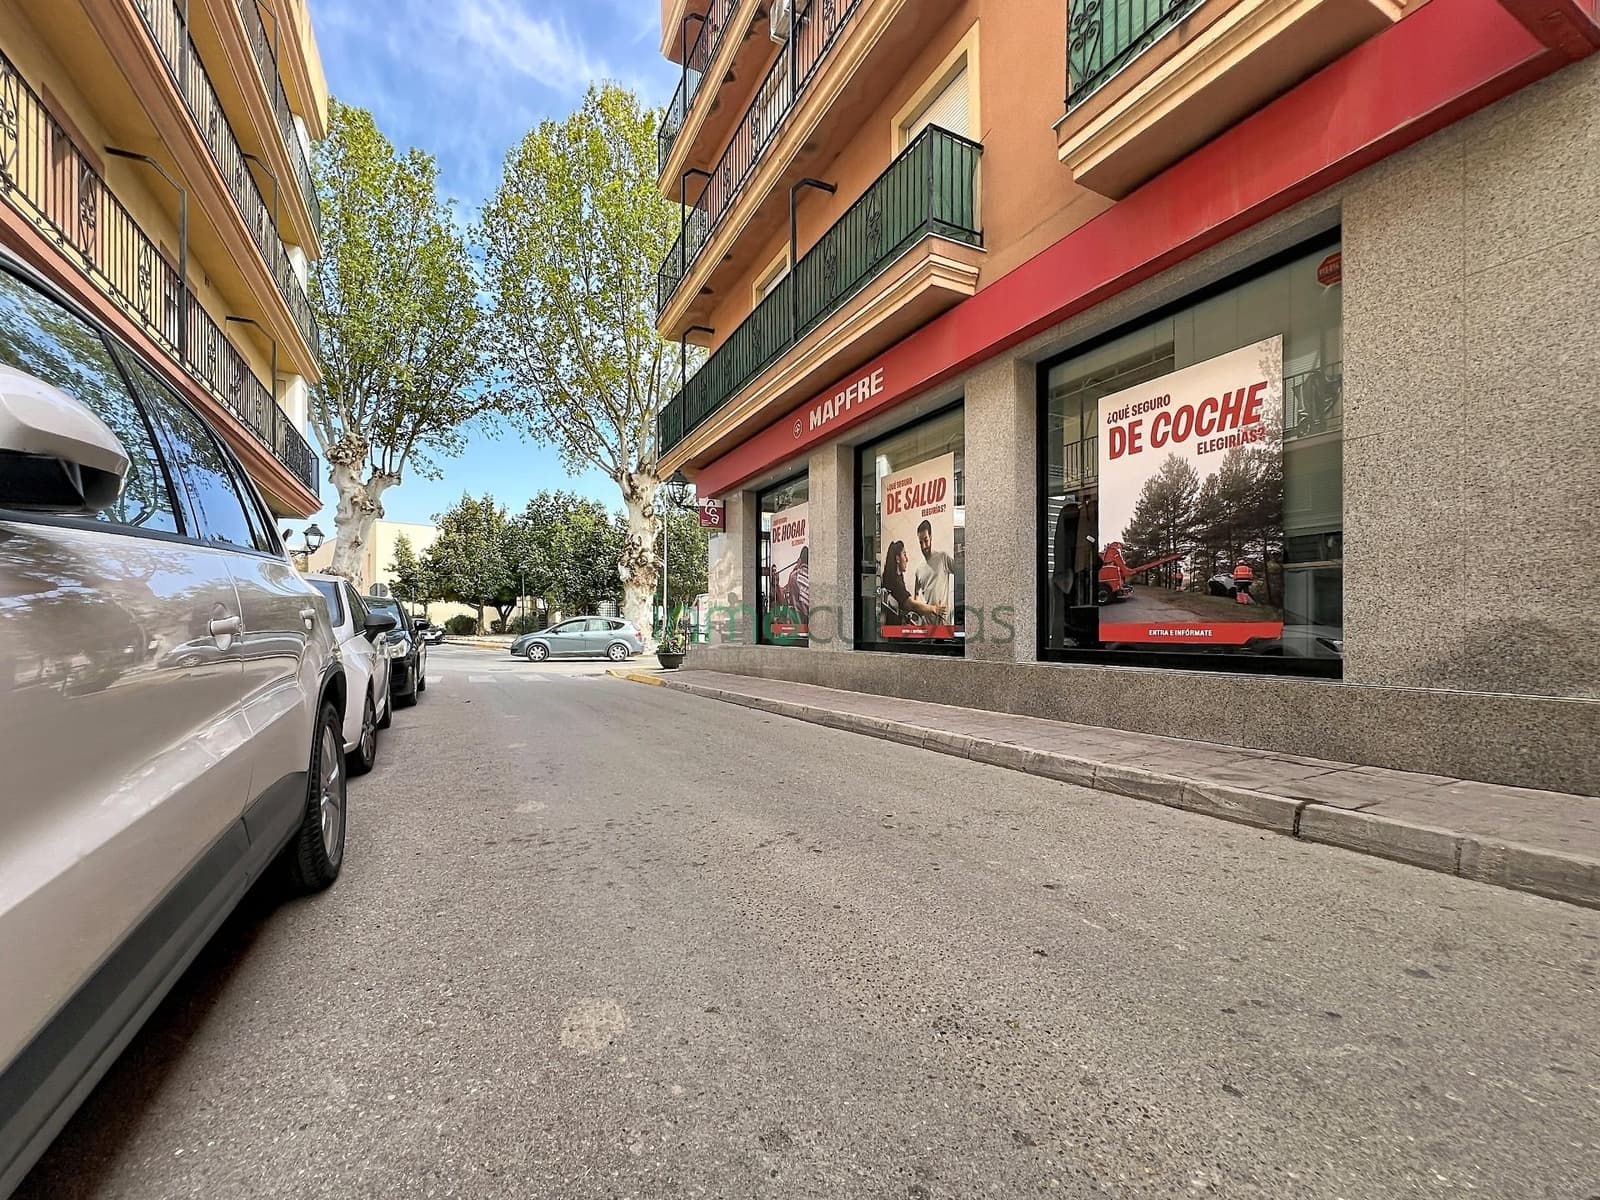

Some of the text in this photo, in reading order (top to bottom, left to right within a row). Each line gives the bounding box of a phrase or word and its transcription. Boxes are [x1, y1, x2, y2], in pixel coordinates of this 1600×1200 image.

[809, 367, 884, 431] MAPFRE
[1107, 394, 1171, 424] ¿QUÉ SEGURO
[1109, 381, 1268, 460] DE COCHE
[1197, 427, 1266, 455] ELEGIRÍAS?
[887, 477, 947, 515] DE SALUD
[772, 519, 806, 543] DE HOGAR
[1175, 628, 1213, 637] INFÓRMATE
